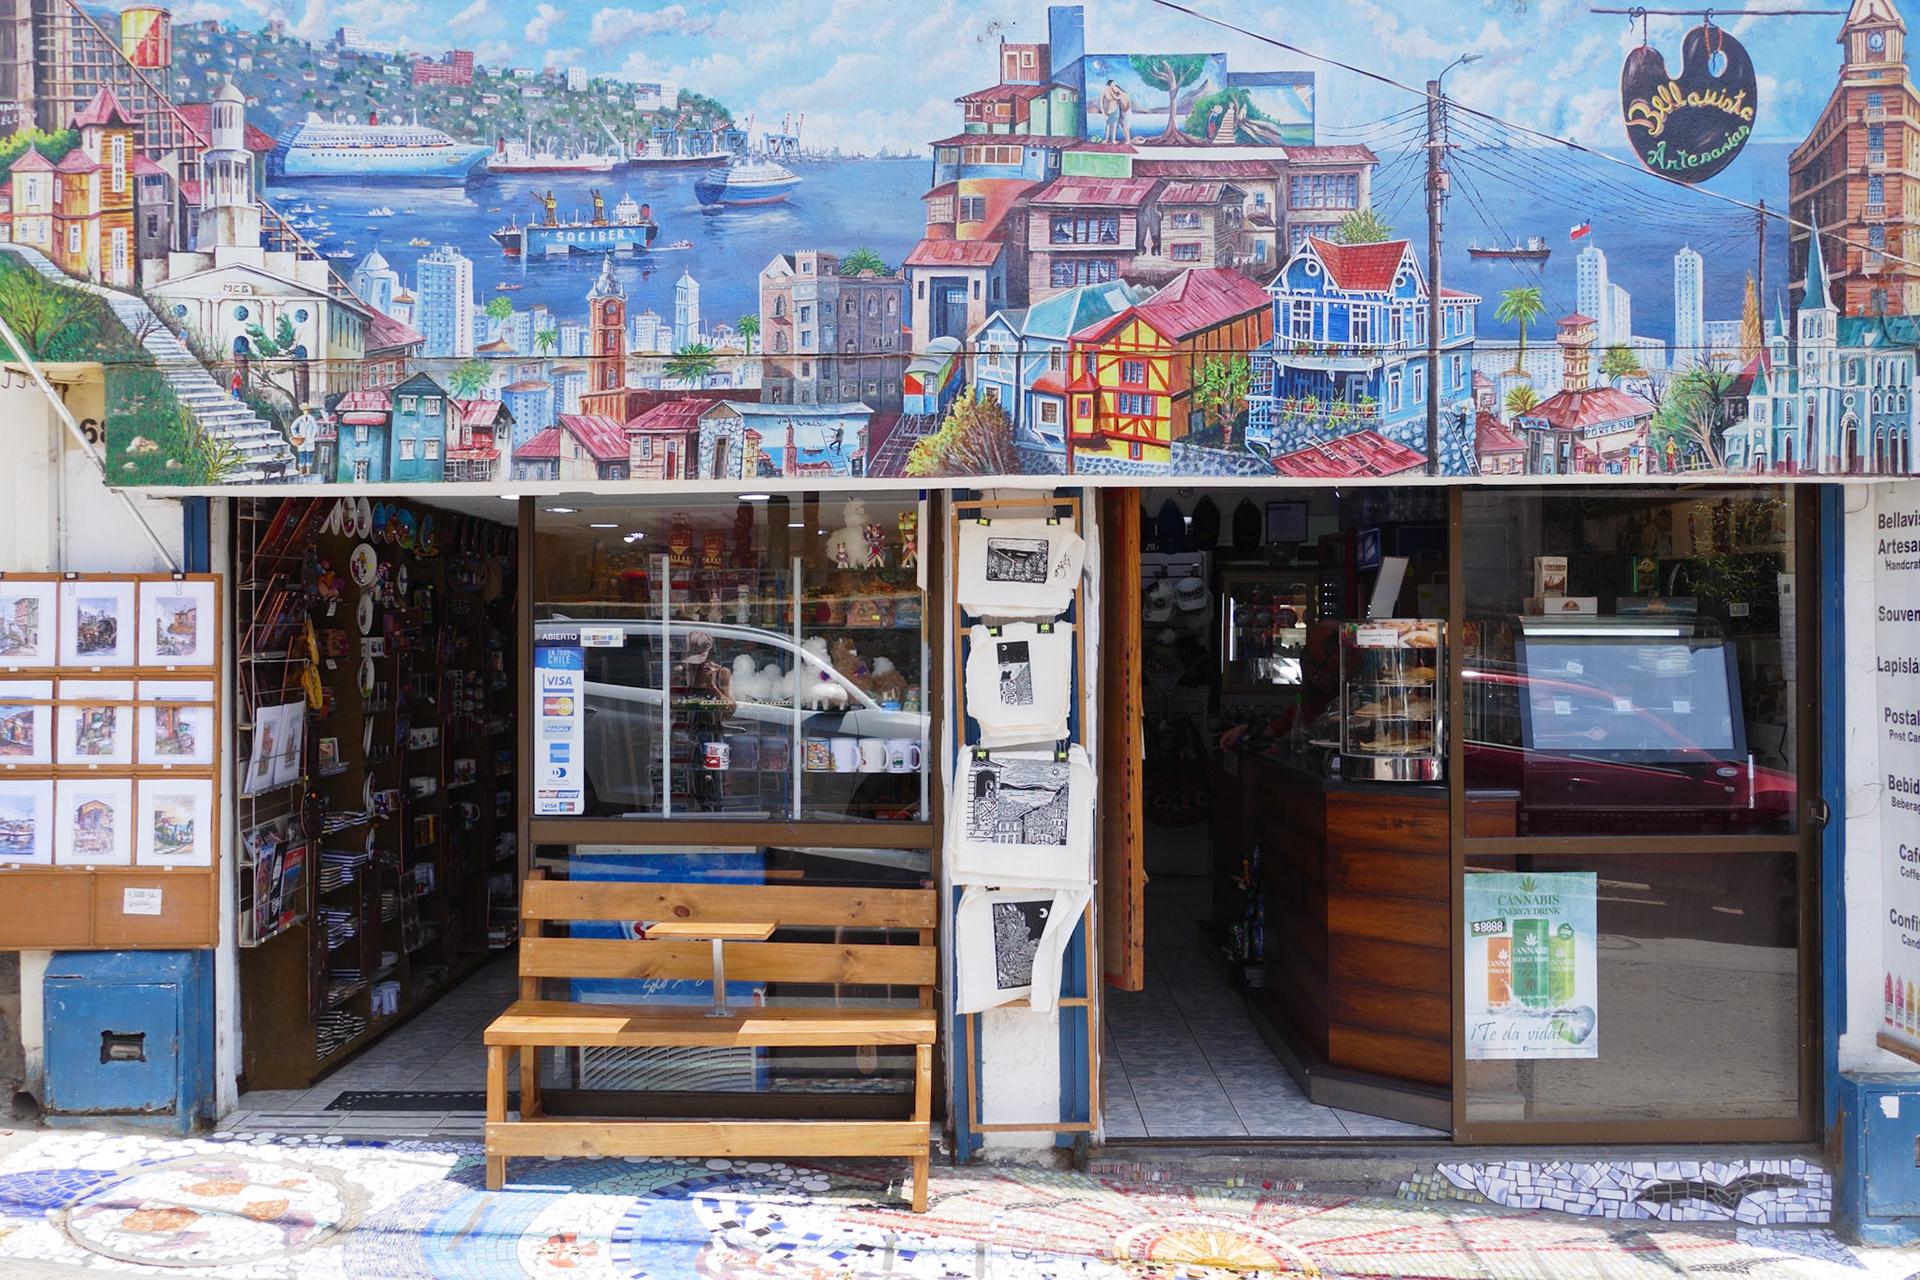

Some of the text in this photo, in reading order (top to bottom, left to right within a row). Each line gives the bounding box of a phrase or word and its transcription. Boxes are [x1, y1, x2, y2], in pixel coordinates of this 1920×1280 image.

[1878, 510, 1920, 530] Bellavi
[542, 633, 577, 641] ABIERTO
[548, 655, 571, 664] CHILE
[1877, 656, 1920, 677] Lapislá
[547, 676, 573, 686] VISA
[1889, 729, 1906, 742] Post
[1899, 843, 1920, 863] Caf
[1497, 894, 1560, 906] CANNABIS
[1498, 907, 1560, 916] ENERGY DRINK
[1889, 908, 1920, 932] Confi
[1502, 1022, 1519, 1041] da
[1528, 1021, 1564, 1041] vida!
